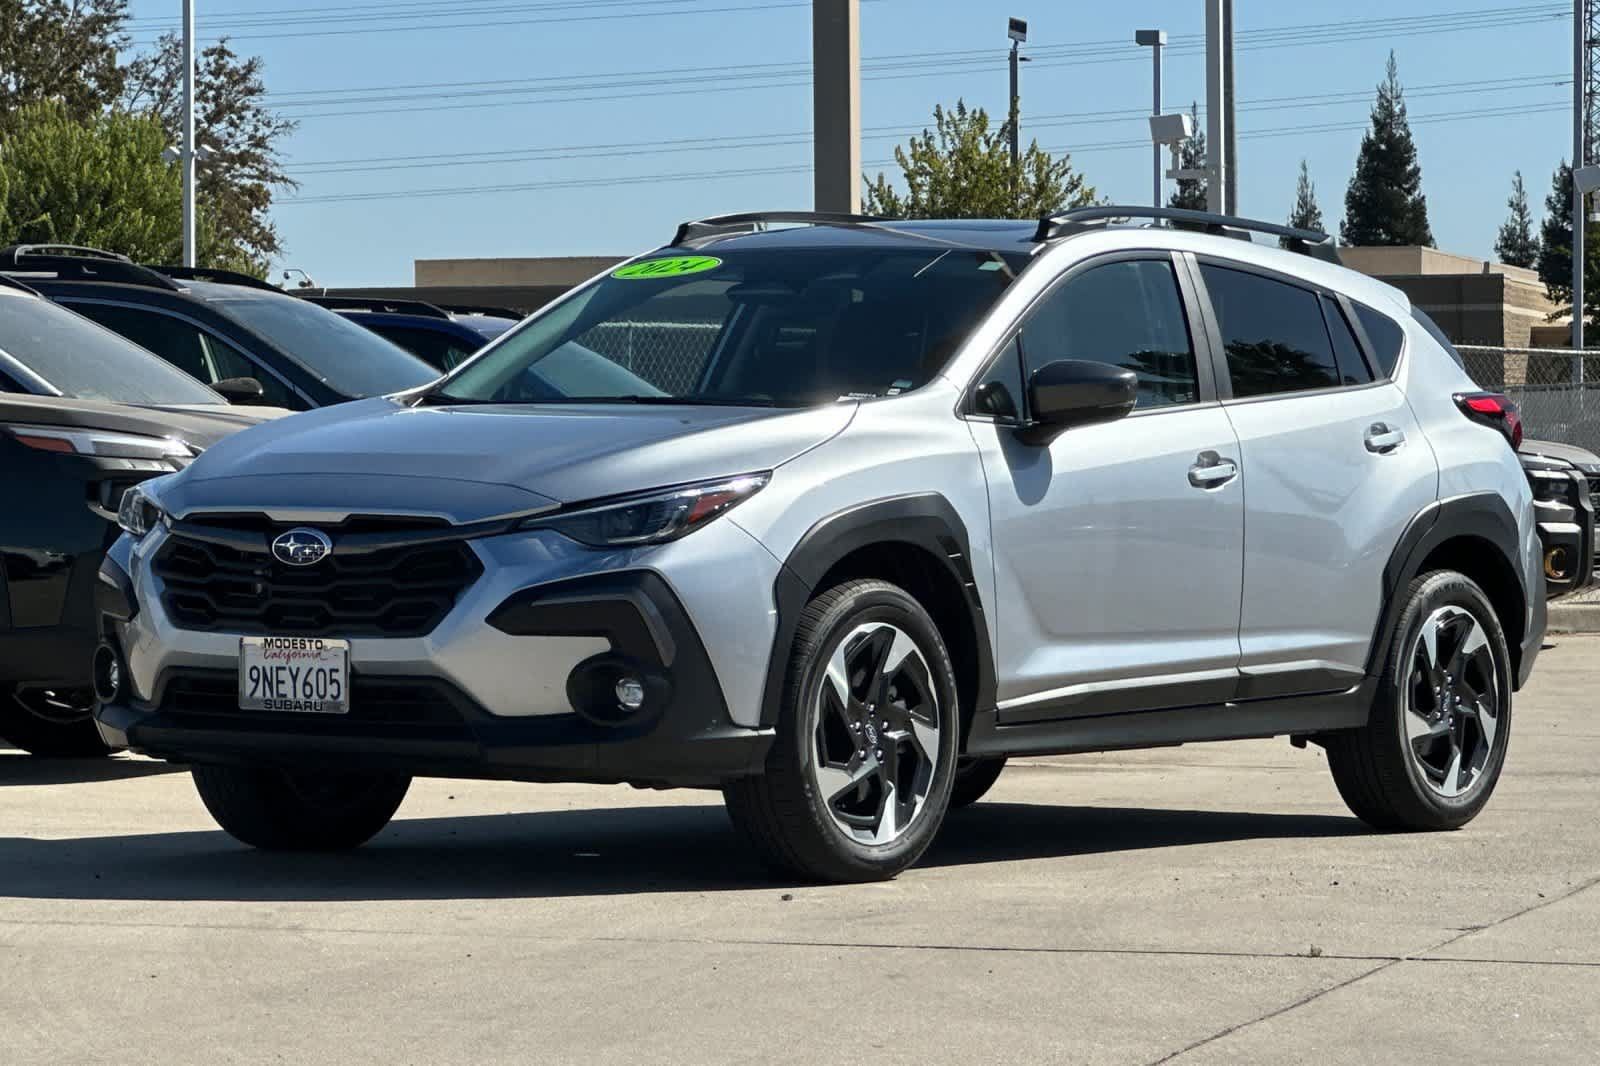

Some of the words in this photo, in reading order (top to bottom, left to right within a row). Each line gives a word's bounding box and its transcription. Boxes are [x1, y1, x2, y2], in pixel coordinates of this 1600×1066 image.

[621, 258, 714, 276] 2024
[264, 638, 323, 650] MODESTO
[264, 649, 328, 664] California
[249, 665, 341, 700] 9NEY605
[264, 698, 323, 711] SUBARU
